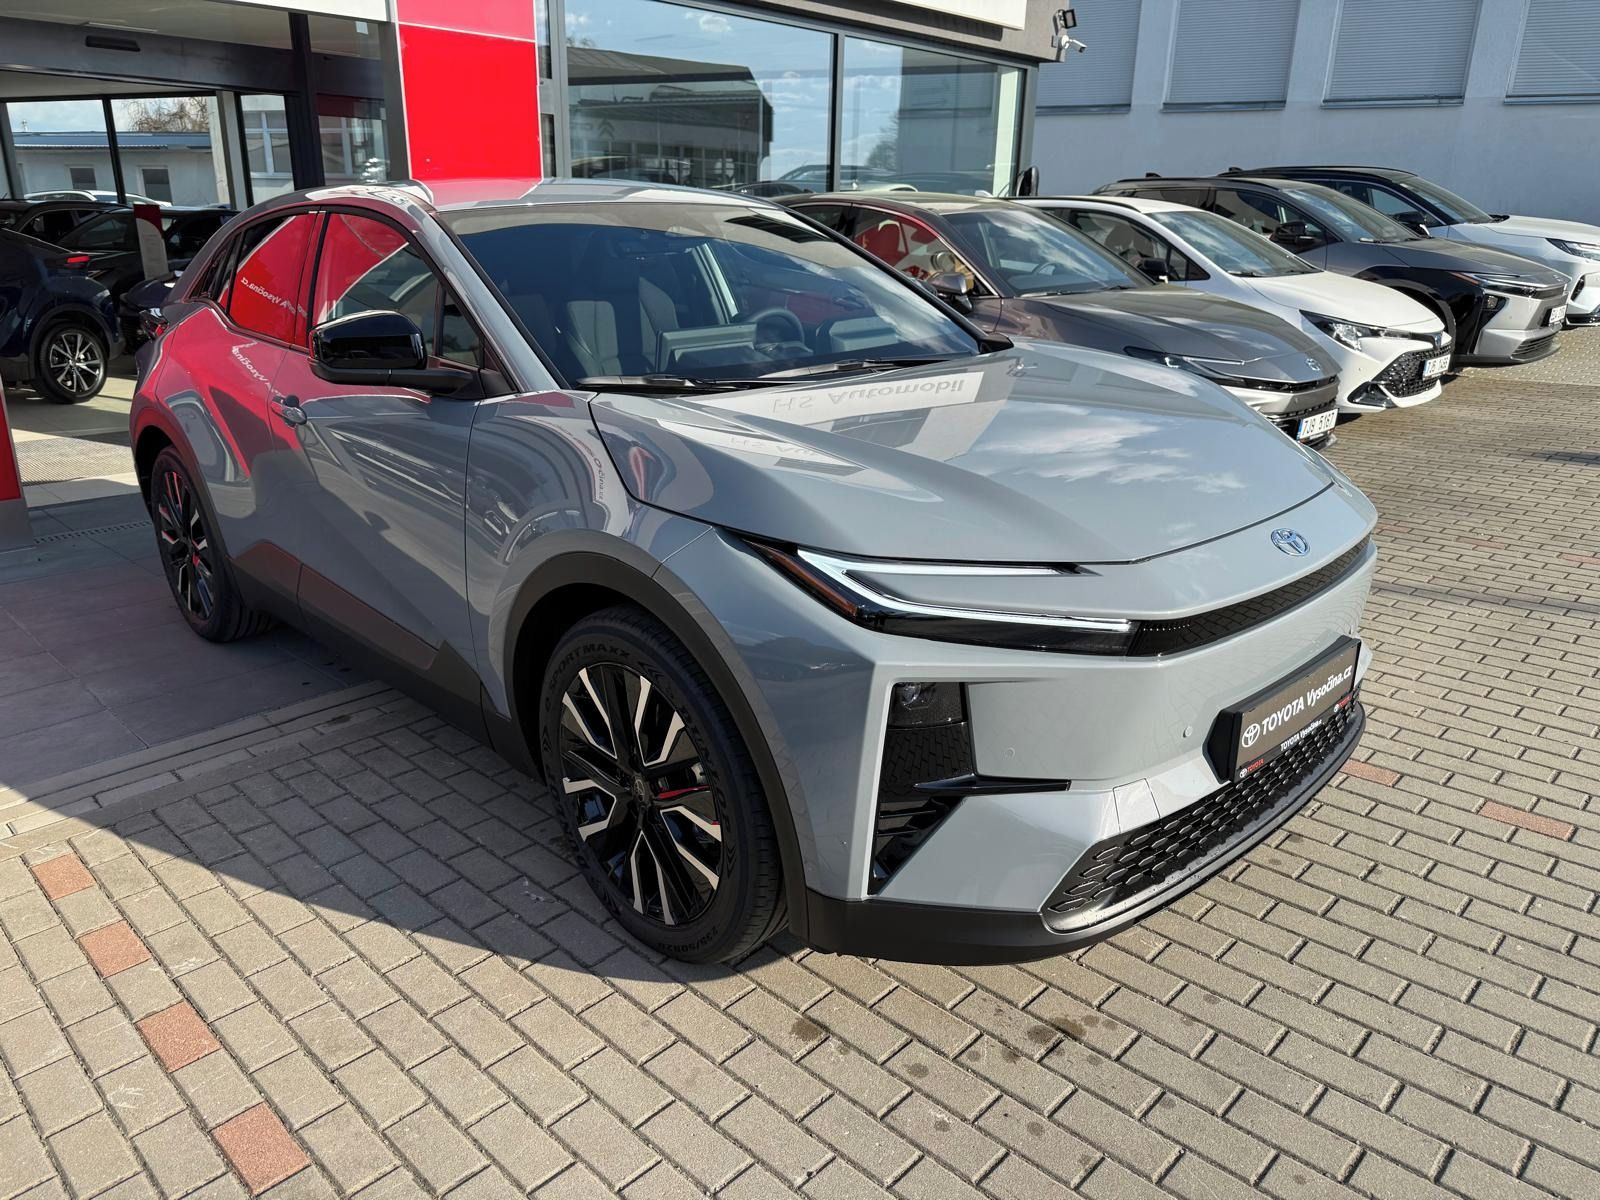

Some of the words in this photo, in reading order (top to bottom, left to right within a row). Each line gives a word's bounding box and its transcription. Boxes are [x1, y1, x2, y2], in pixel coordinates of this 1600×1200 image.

[1261, 696, 1304, 735] TOYOTA
[1306, 665, 1353, 707] Vysočina.cz
[1280, 732, 1300, 751] TOYOTA
